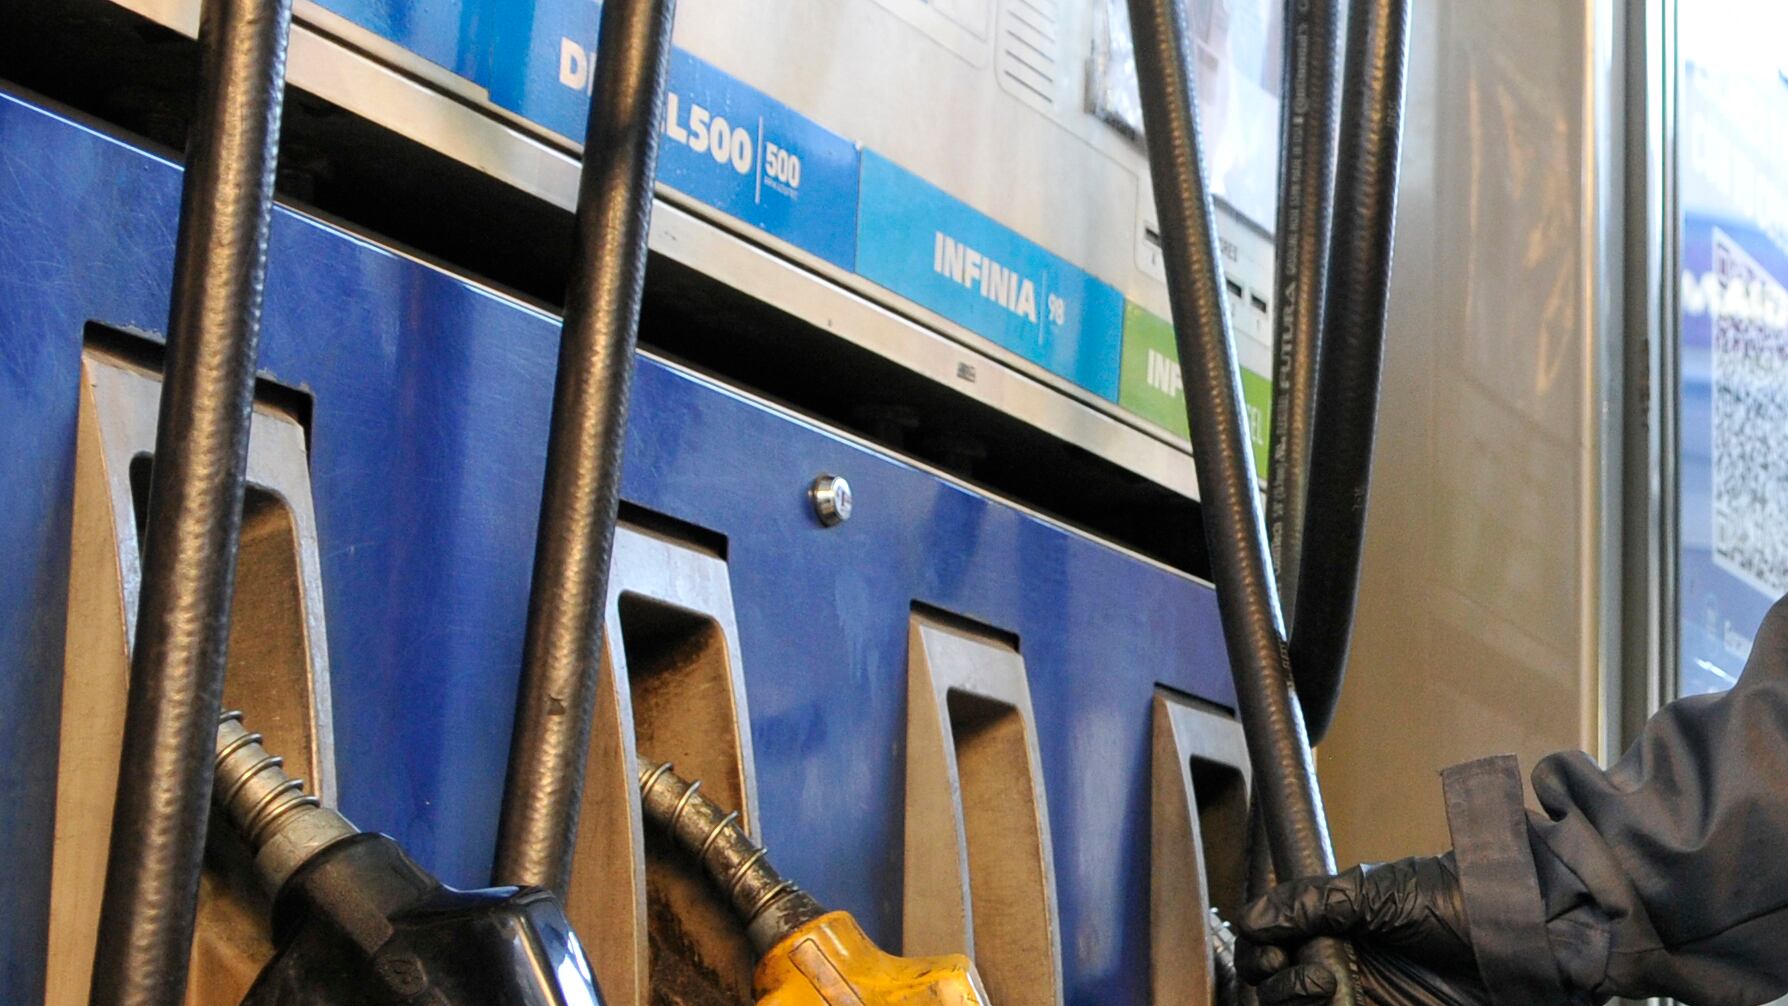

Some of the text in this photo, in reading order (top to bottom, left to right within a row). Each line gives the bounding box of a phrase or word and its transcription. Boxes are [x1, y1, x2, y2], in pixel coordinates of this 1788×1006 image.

[764, 141, 801, 188] 500
[934, 231, 1065, 326] INFINIA 98
[1279, 280, 1297, 388] FUTURA
